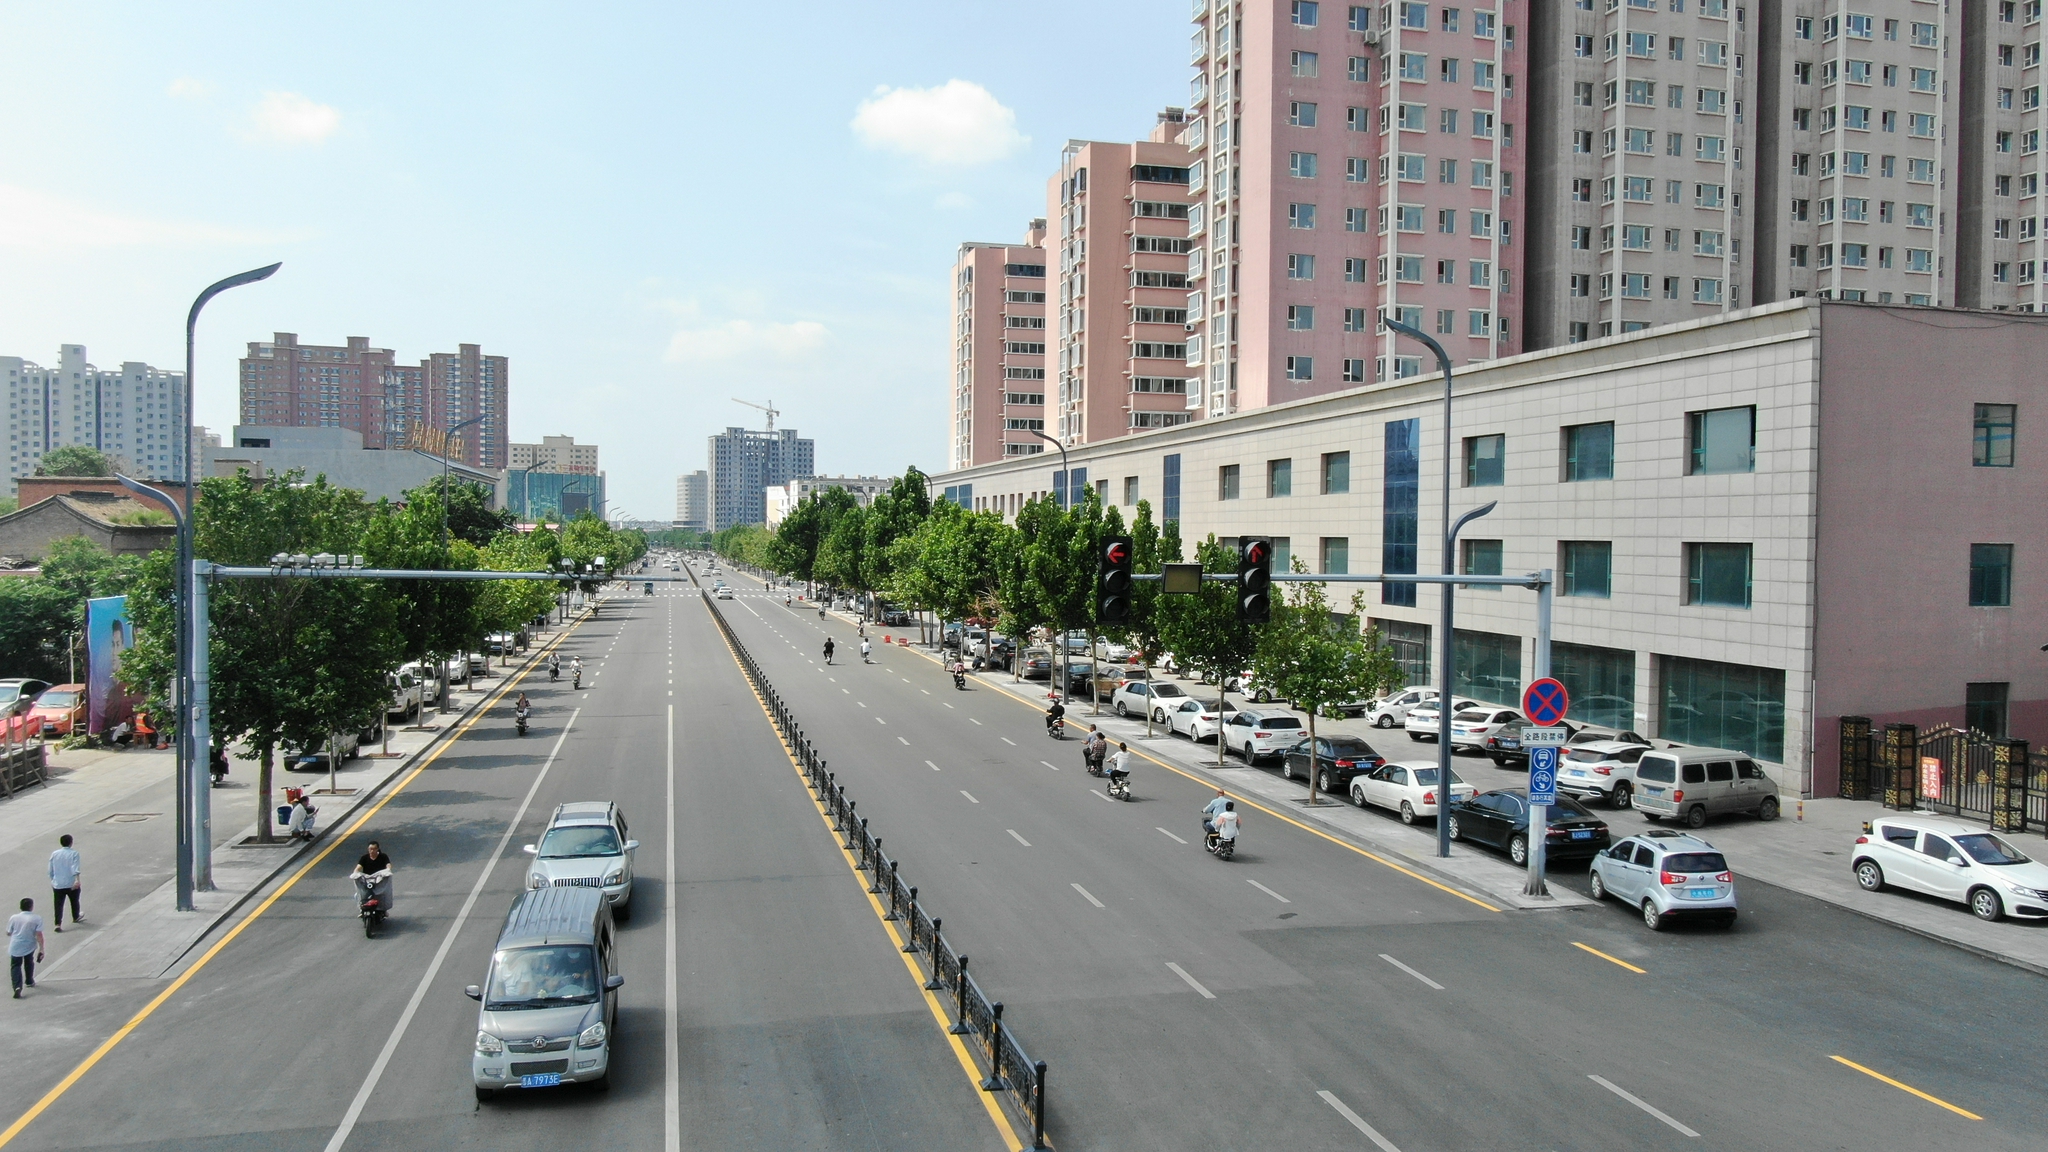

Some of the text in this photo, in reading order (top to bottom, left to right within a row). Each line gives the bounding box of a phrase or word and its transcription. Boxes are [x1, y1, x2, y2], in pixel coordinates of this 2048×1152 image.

[1524, 732, 1564, 741] 全路段禁停
